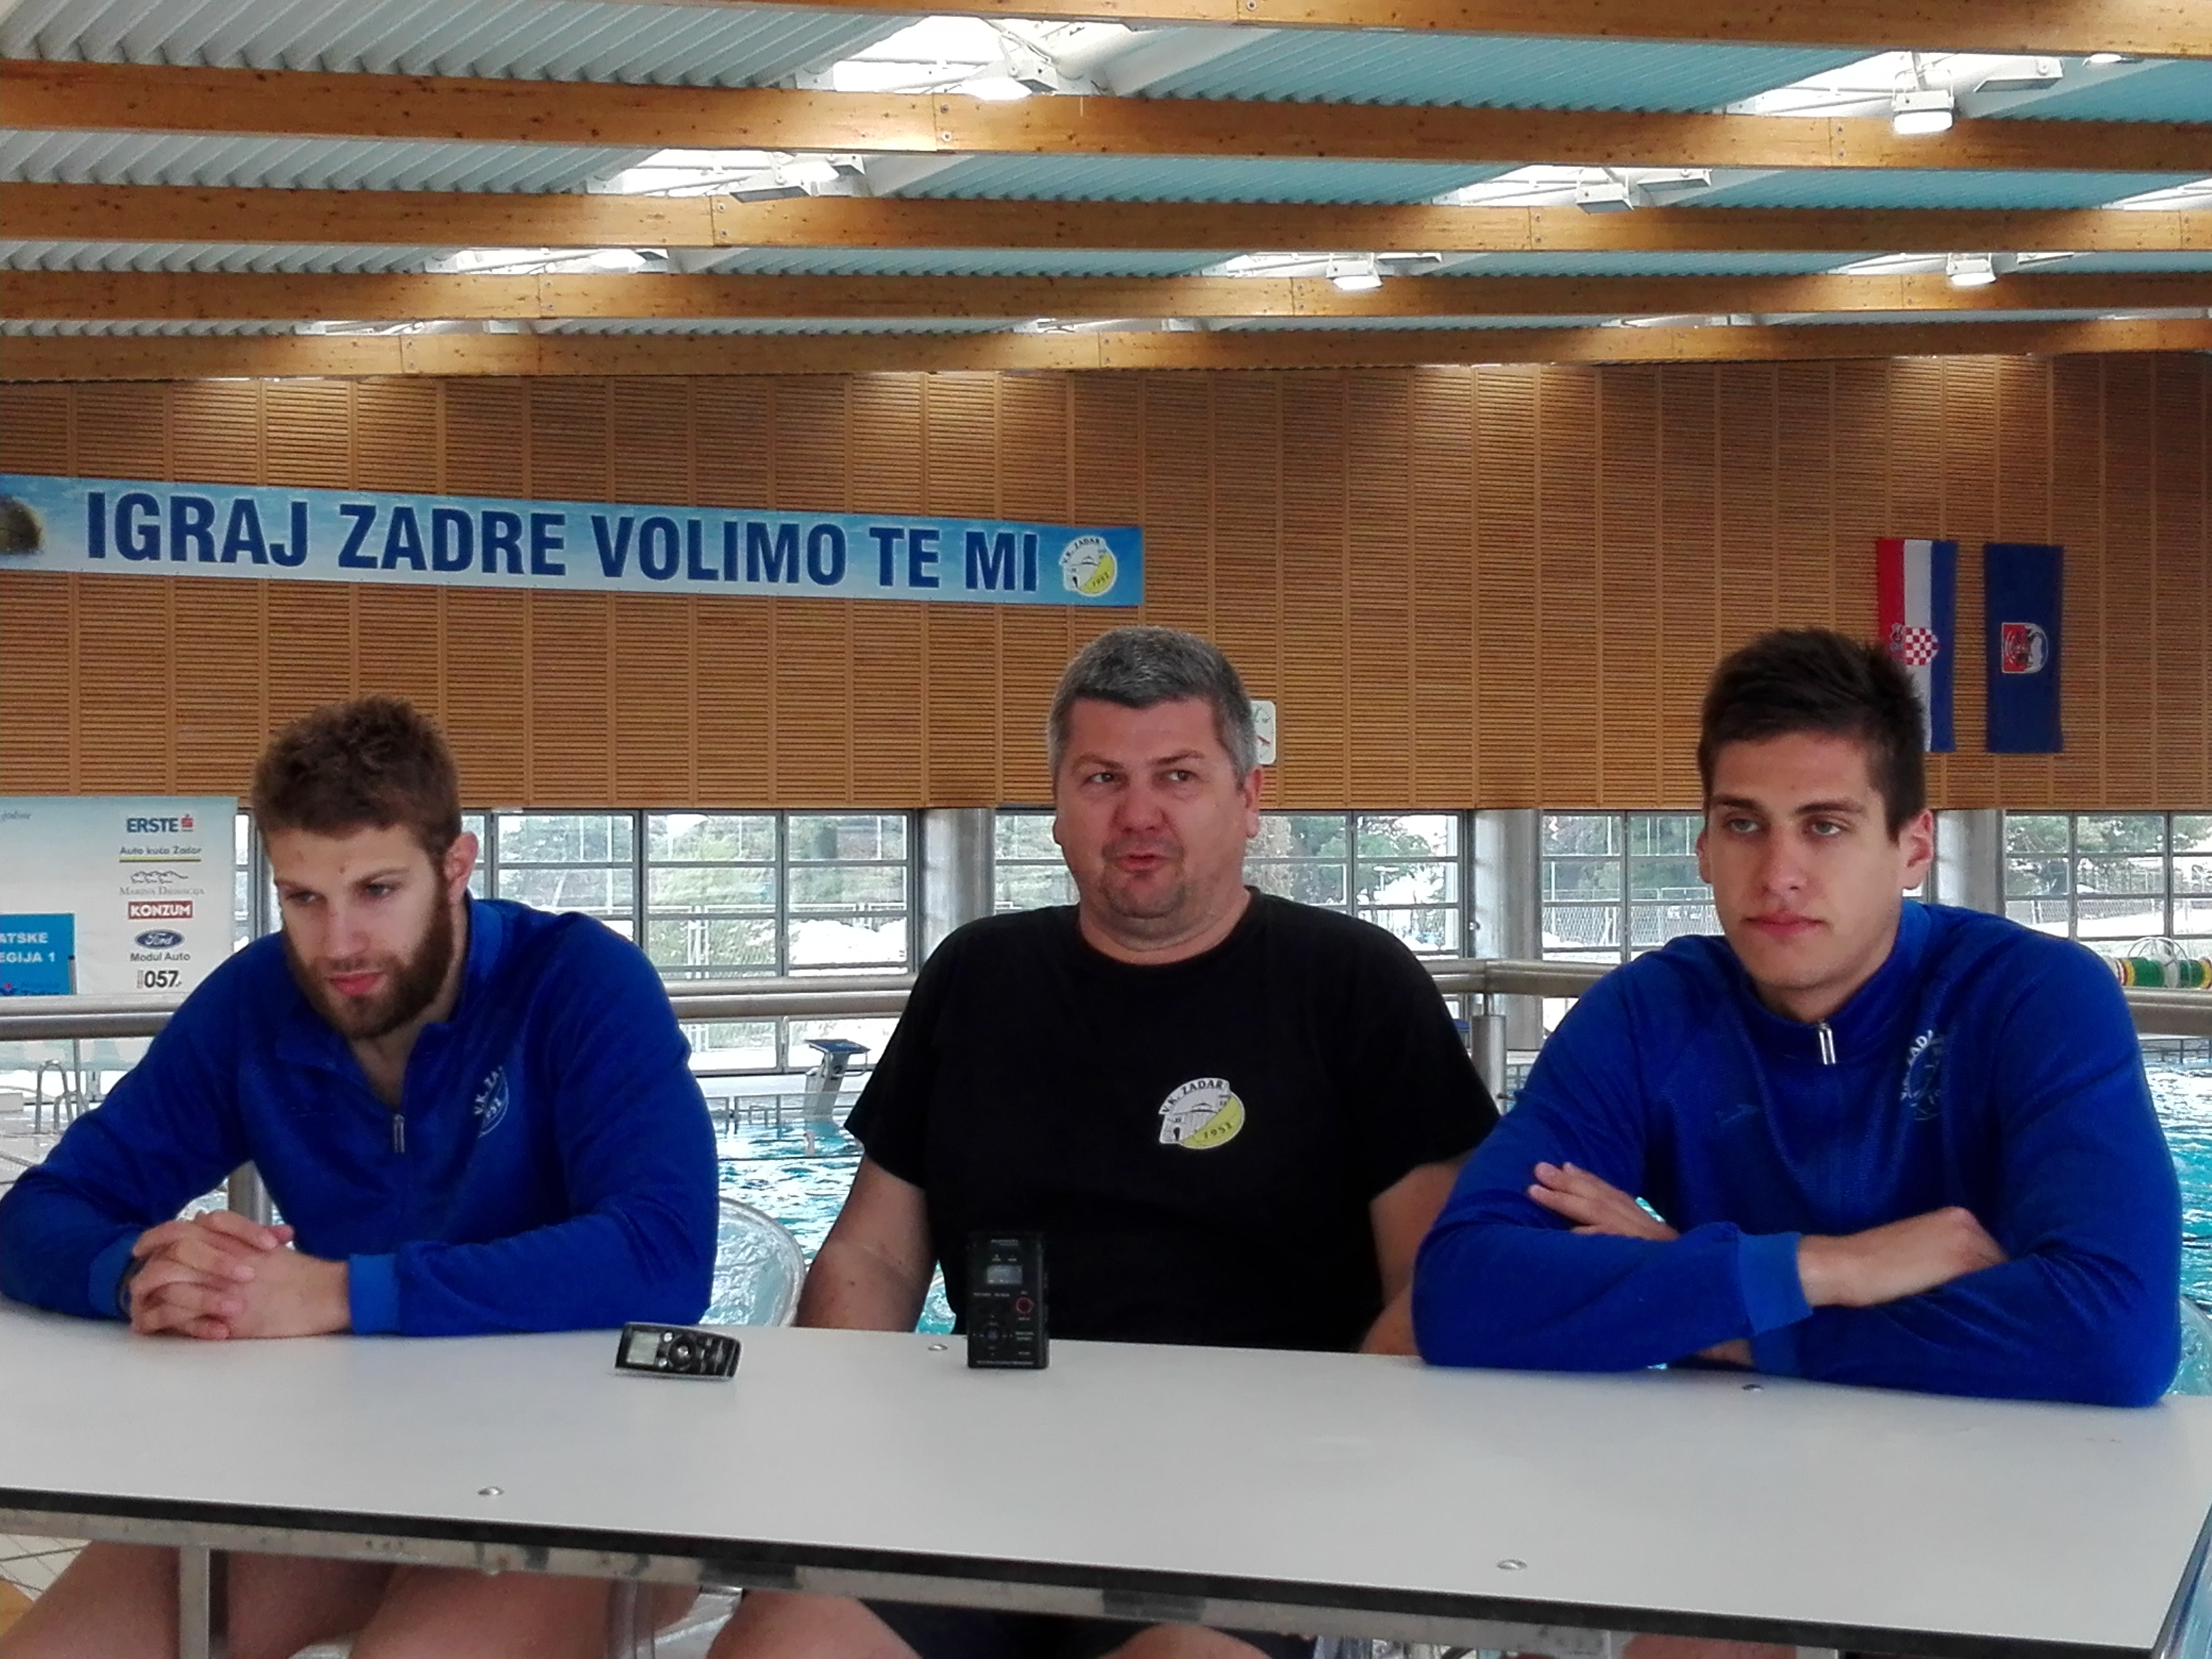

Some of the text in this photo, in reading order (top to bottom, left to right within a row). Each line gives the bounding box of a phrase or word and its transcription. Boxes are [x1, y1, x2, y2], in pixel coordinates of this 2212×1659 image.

[87, 491, 1038, 592] IGRAJ ZADRE VOLIMO TE MI
[1074, 537, 1100, 549] ZADAR
[127, 818, 179, 833] ERSTE
[130, 903, 191, 917] KONZUM
[145, 933, 174, 945] Ford
[48, 951, 55, 963] 1
[164, 952, 191, 961] Auto
[1182, 1079, 1224, 1095] ZADAR
